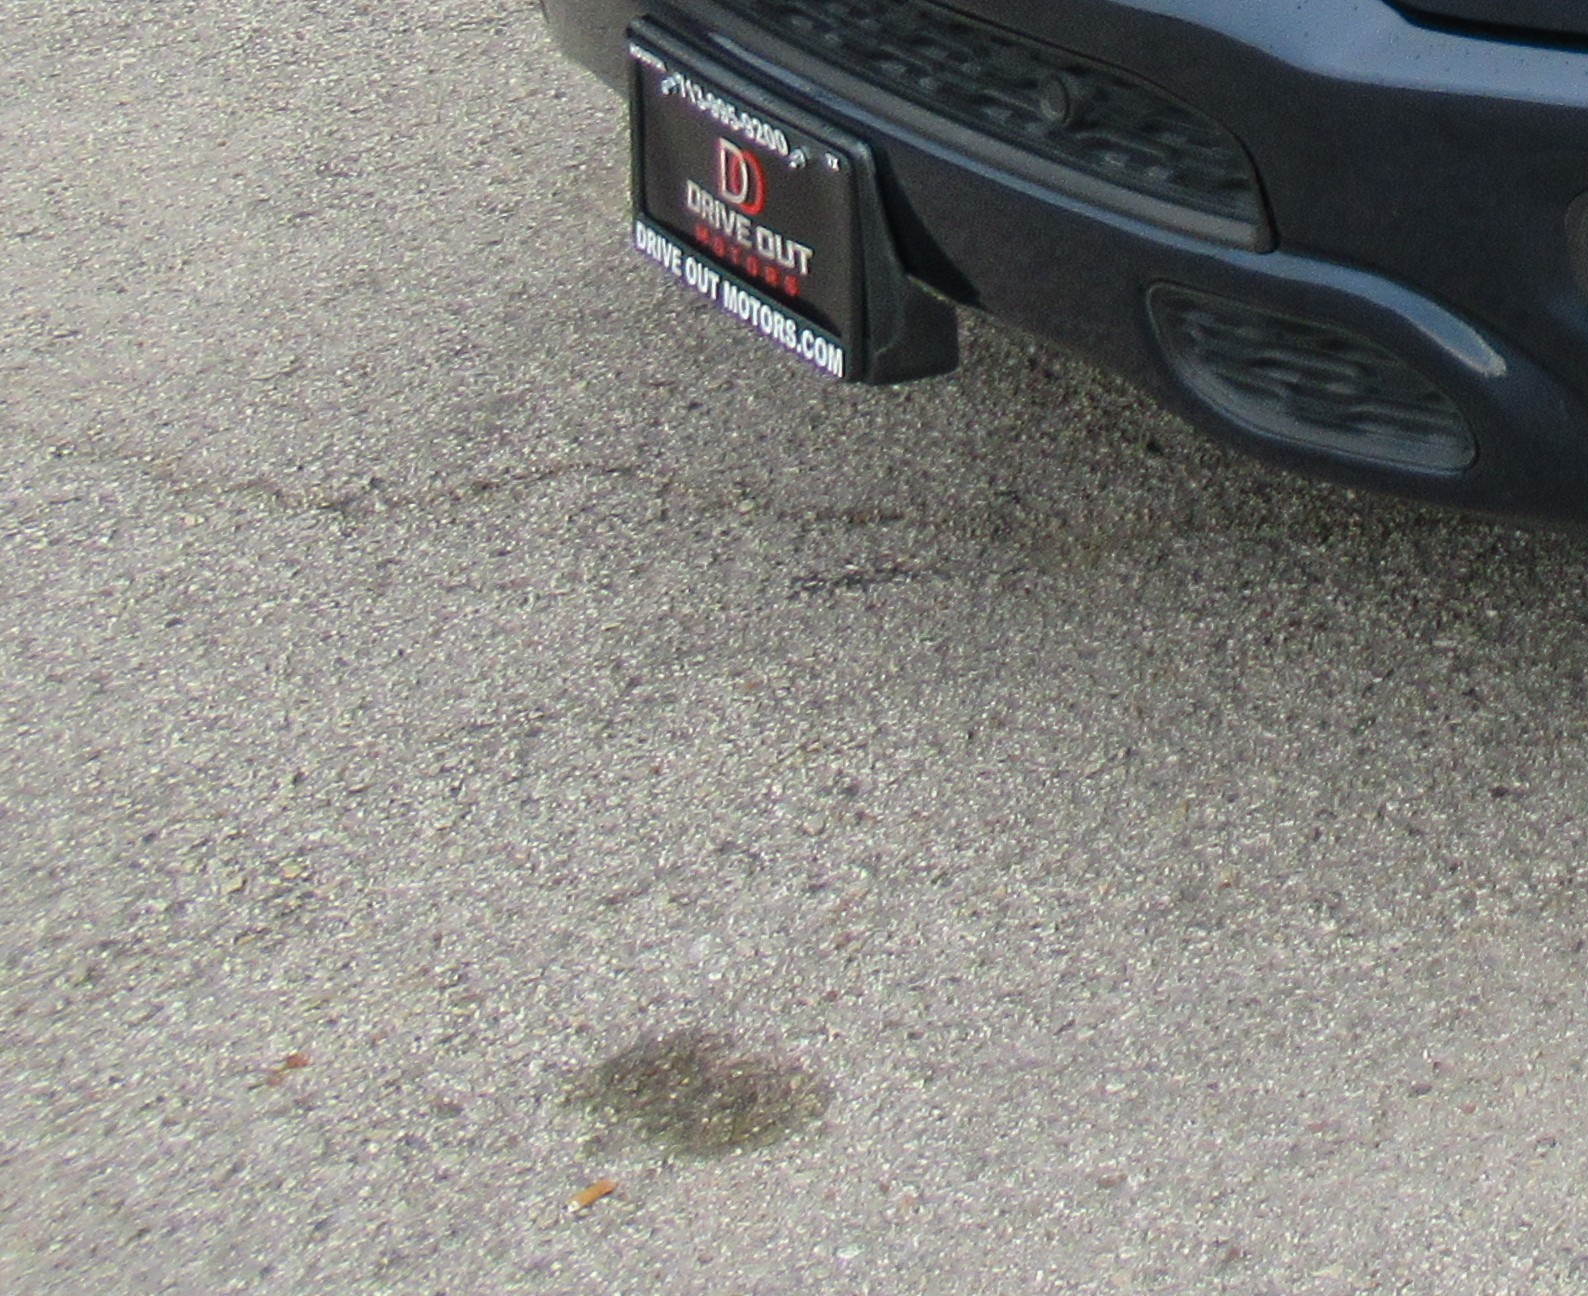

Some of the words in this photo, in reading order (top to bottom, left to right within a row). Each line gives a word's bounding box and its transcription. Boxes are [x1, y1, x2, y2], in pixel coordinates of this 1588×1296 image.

[686, 178, 753, 250] DRIVE
[756, 225, 814, 276] OUT
[635, 220, 683, 276] DRIVE
[684, 255, 721, 301] OUT
[722, 279, 845, 379] MOTORS.COM
